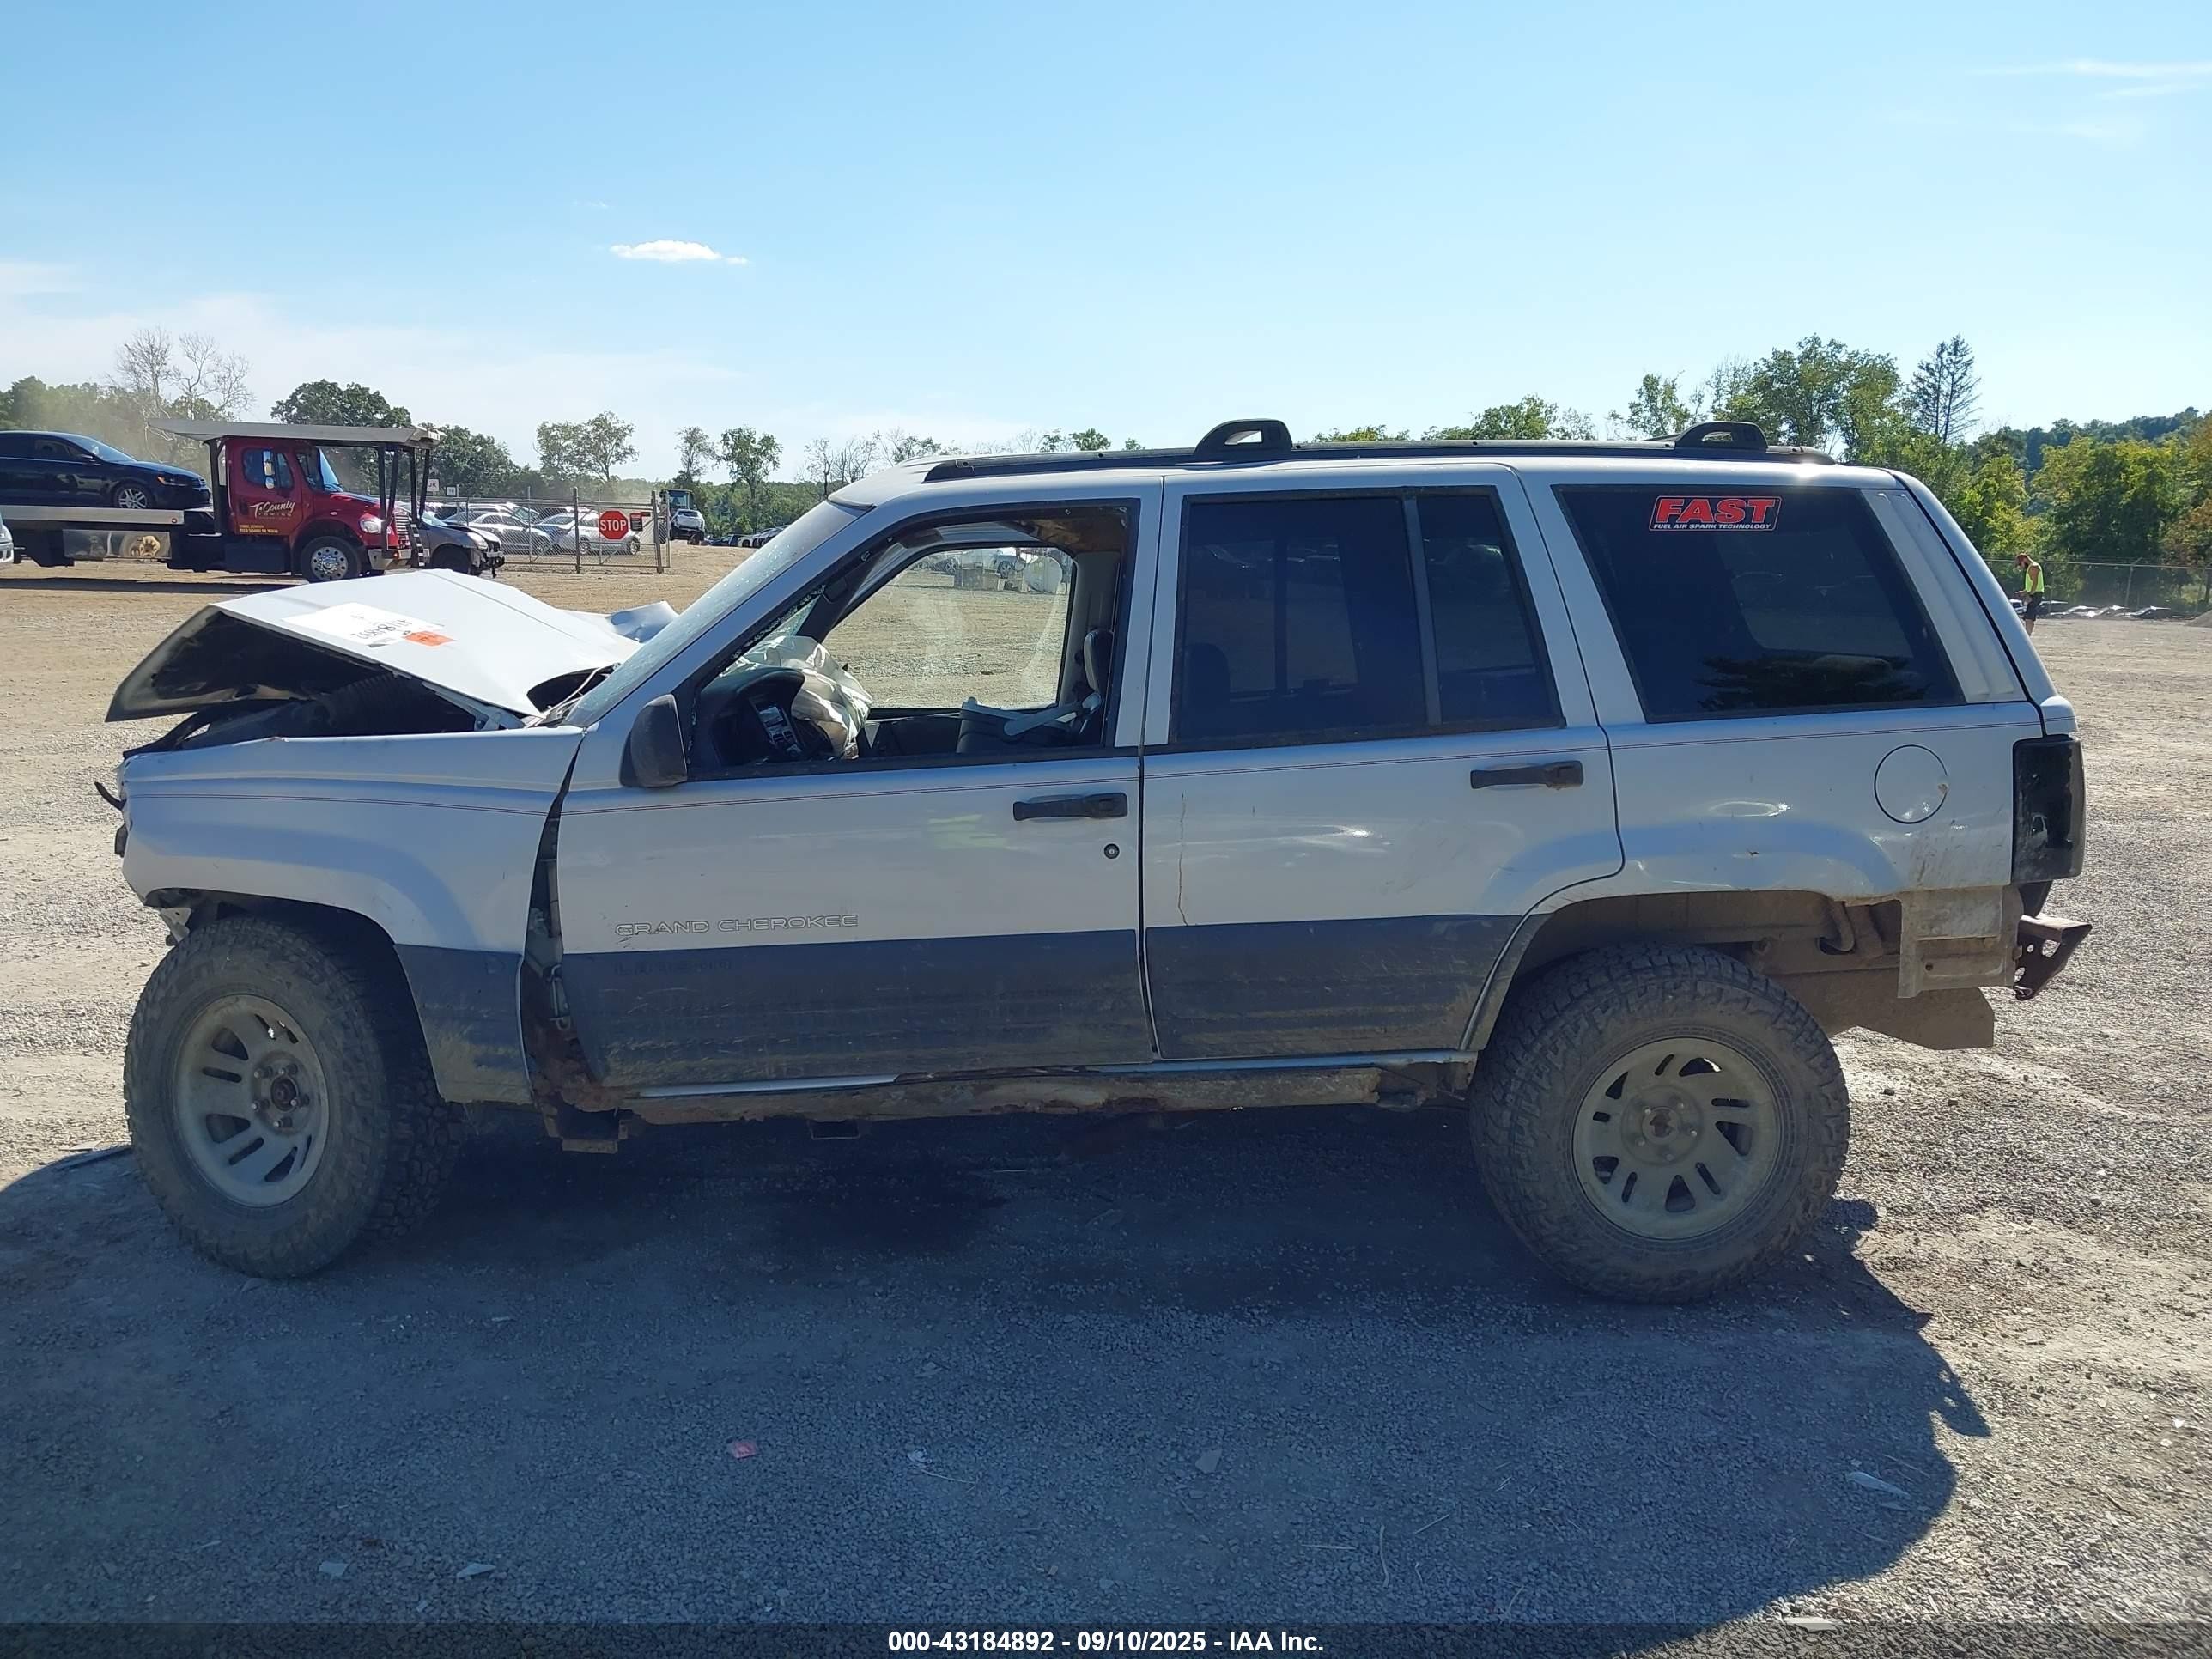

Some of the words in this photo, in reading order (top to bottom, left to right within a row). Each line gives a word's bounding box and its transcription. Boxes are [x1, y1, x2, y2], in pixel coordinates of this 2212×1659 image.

[1655, 498, 1776, 524] FAST
[599, 520, 627, 531] STOP
[615, 921, 709, 936] GRAND
[718, 915, 859, 933] CHEROKEE
